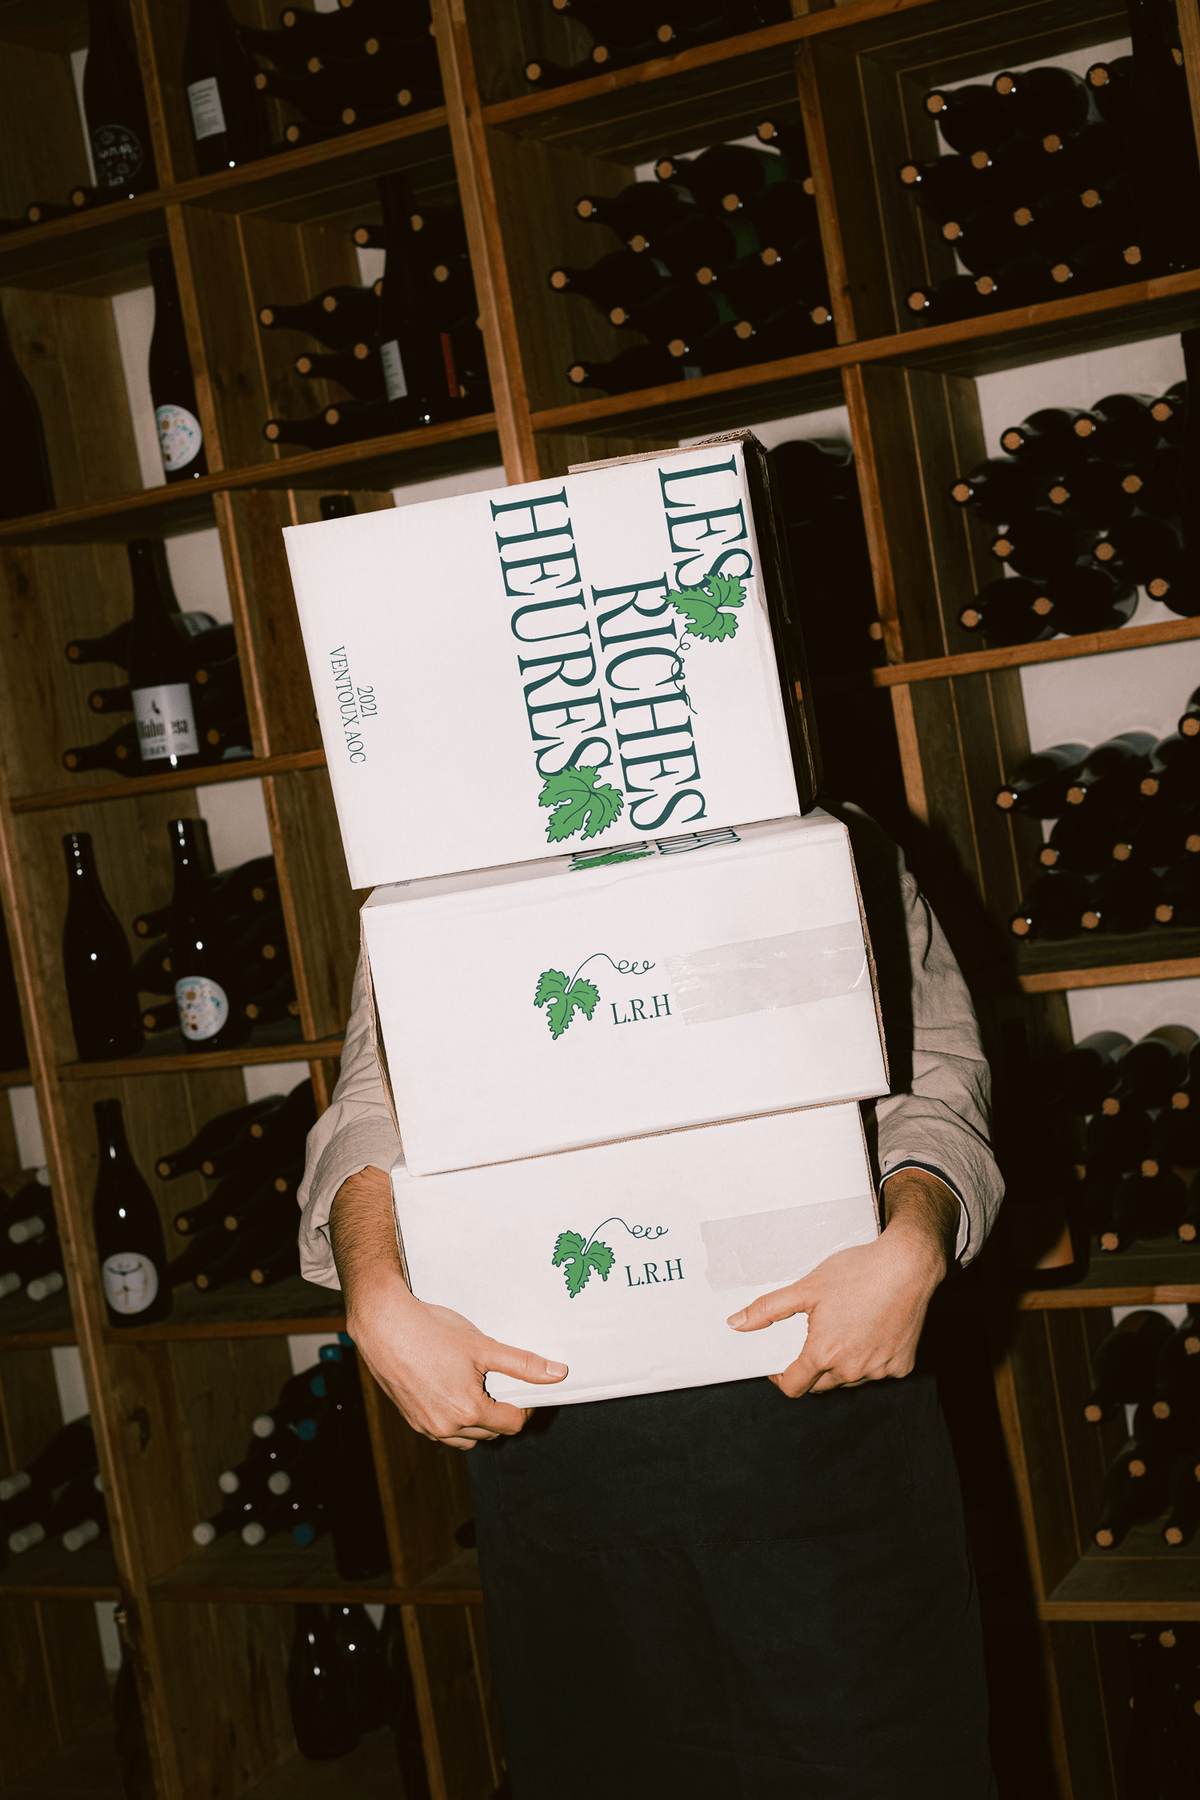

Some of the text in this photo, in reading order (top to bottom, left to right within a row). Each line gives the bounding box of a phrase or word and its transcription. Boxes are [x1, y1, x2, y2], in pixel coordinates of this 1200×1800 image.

[658, 454, 755, 592] LES
[490, 486, 613, 777] HEURES
[329, 645, 367, 764] VENTOUX AOC
[356, 685, 378, 718] 2021
[591, 572, 707, 831] RICHES
[610, 993, 672, 1025] L.R.H
[624, 1258, 685, 1287] L.R.H
